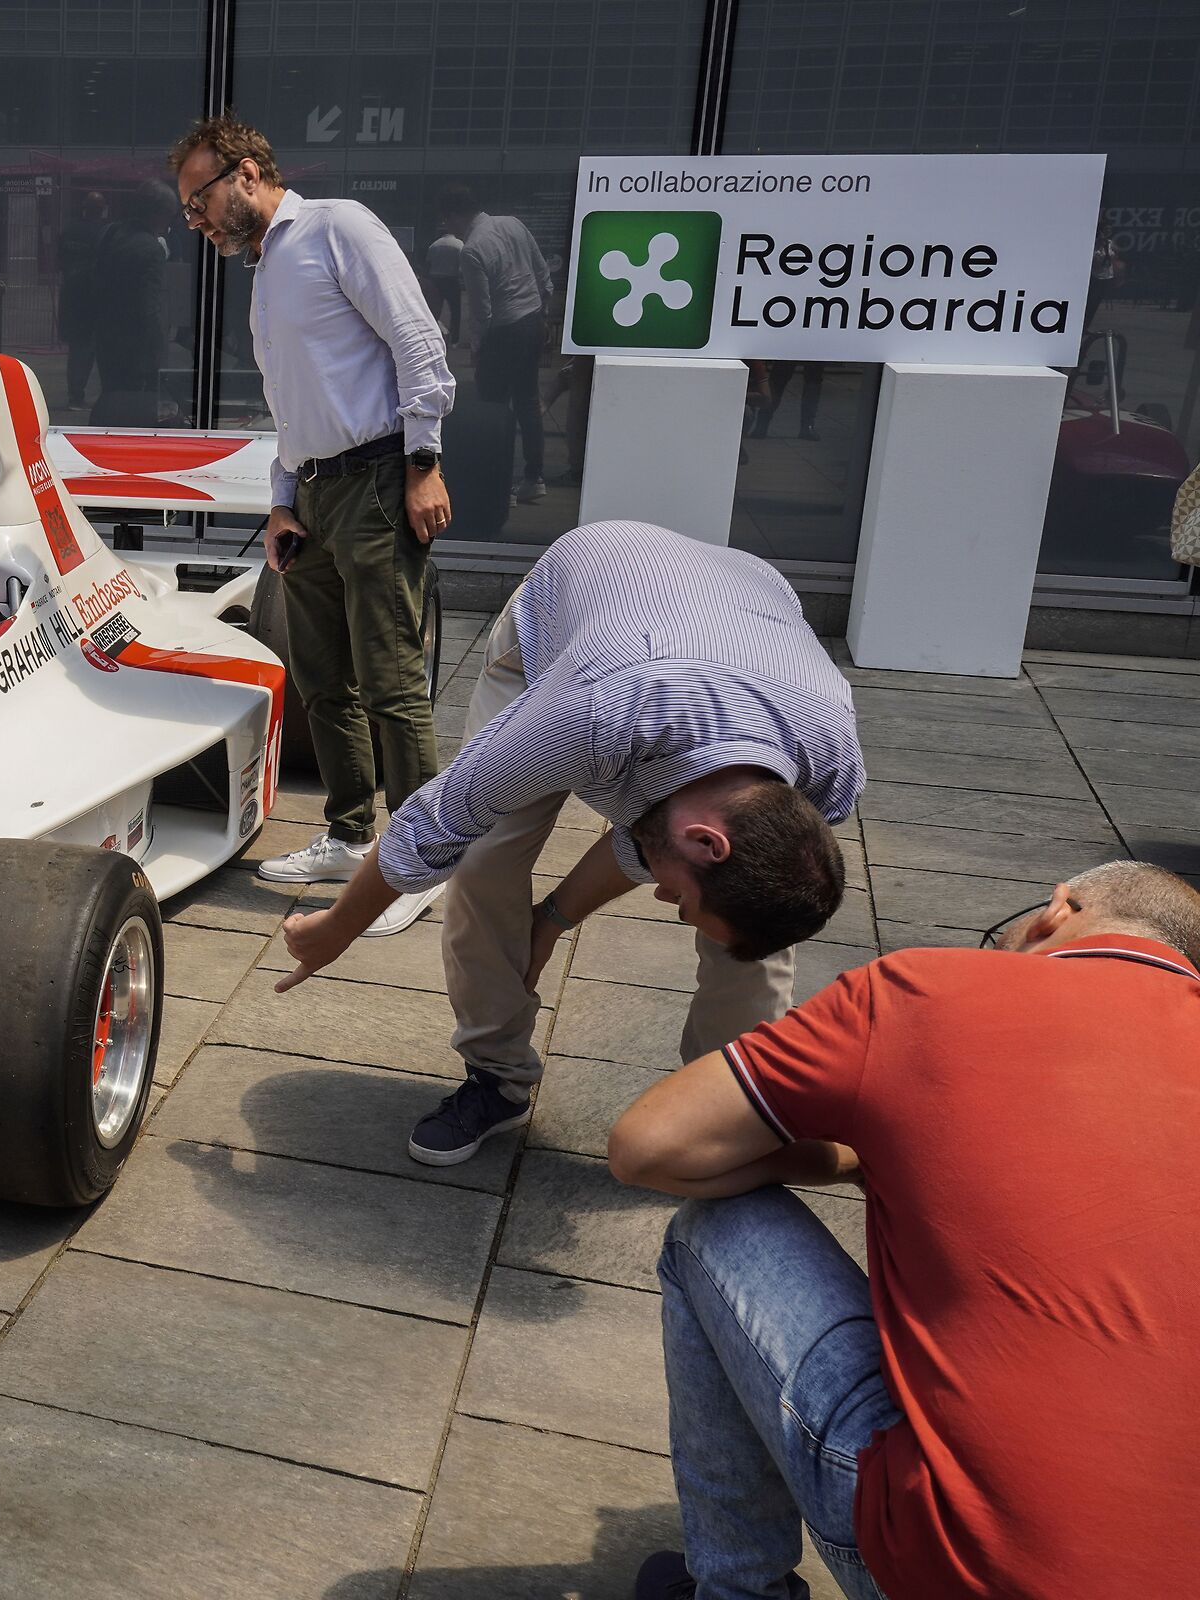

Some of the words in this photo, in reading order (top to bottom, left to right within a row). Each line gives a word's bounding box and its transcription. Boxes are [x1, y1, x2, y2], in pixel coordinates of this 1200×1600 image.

[587, 171, 611, 193] In
[618, 170, 813, 194] collaborazione
[821, 174, 872, 194] con
[736, 233, 998, 288] Regione
[730, 286, 1069, 334] Lombardia
[71, 569, 141, 630] Embassy
[48, 605, 85, 649] HILL
